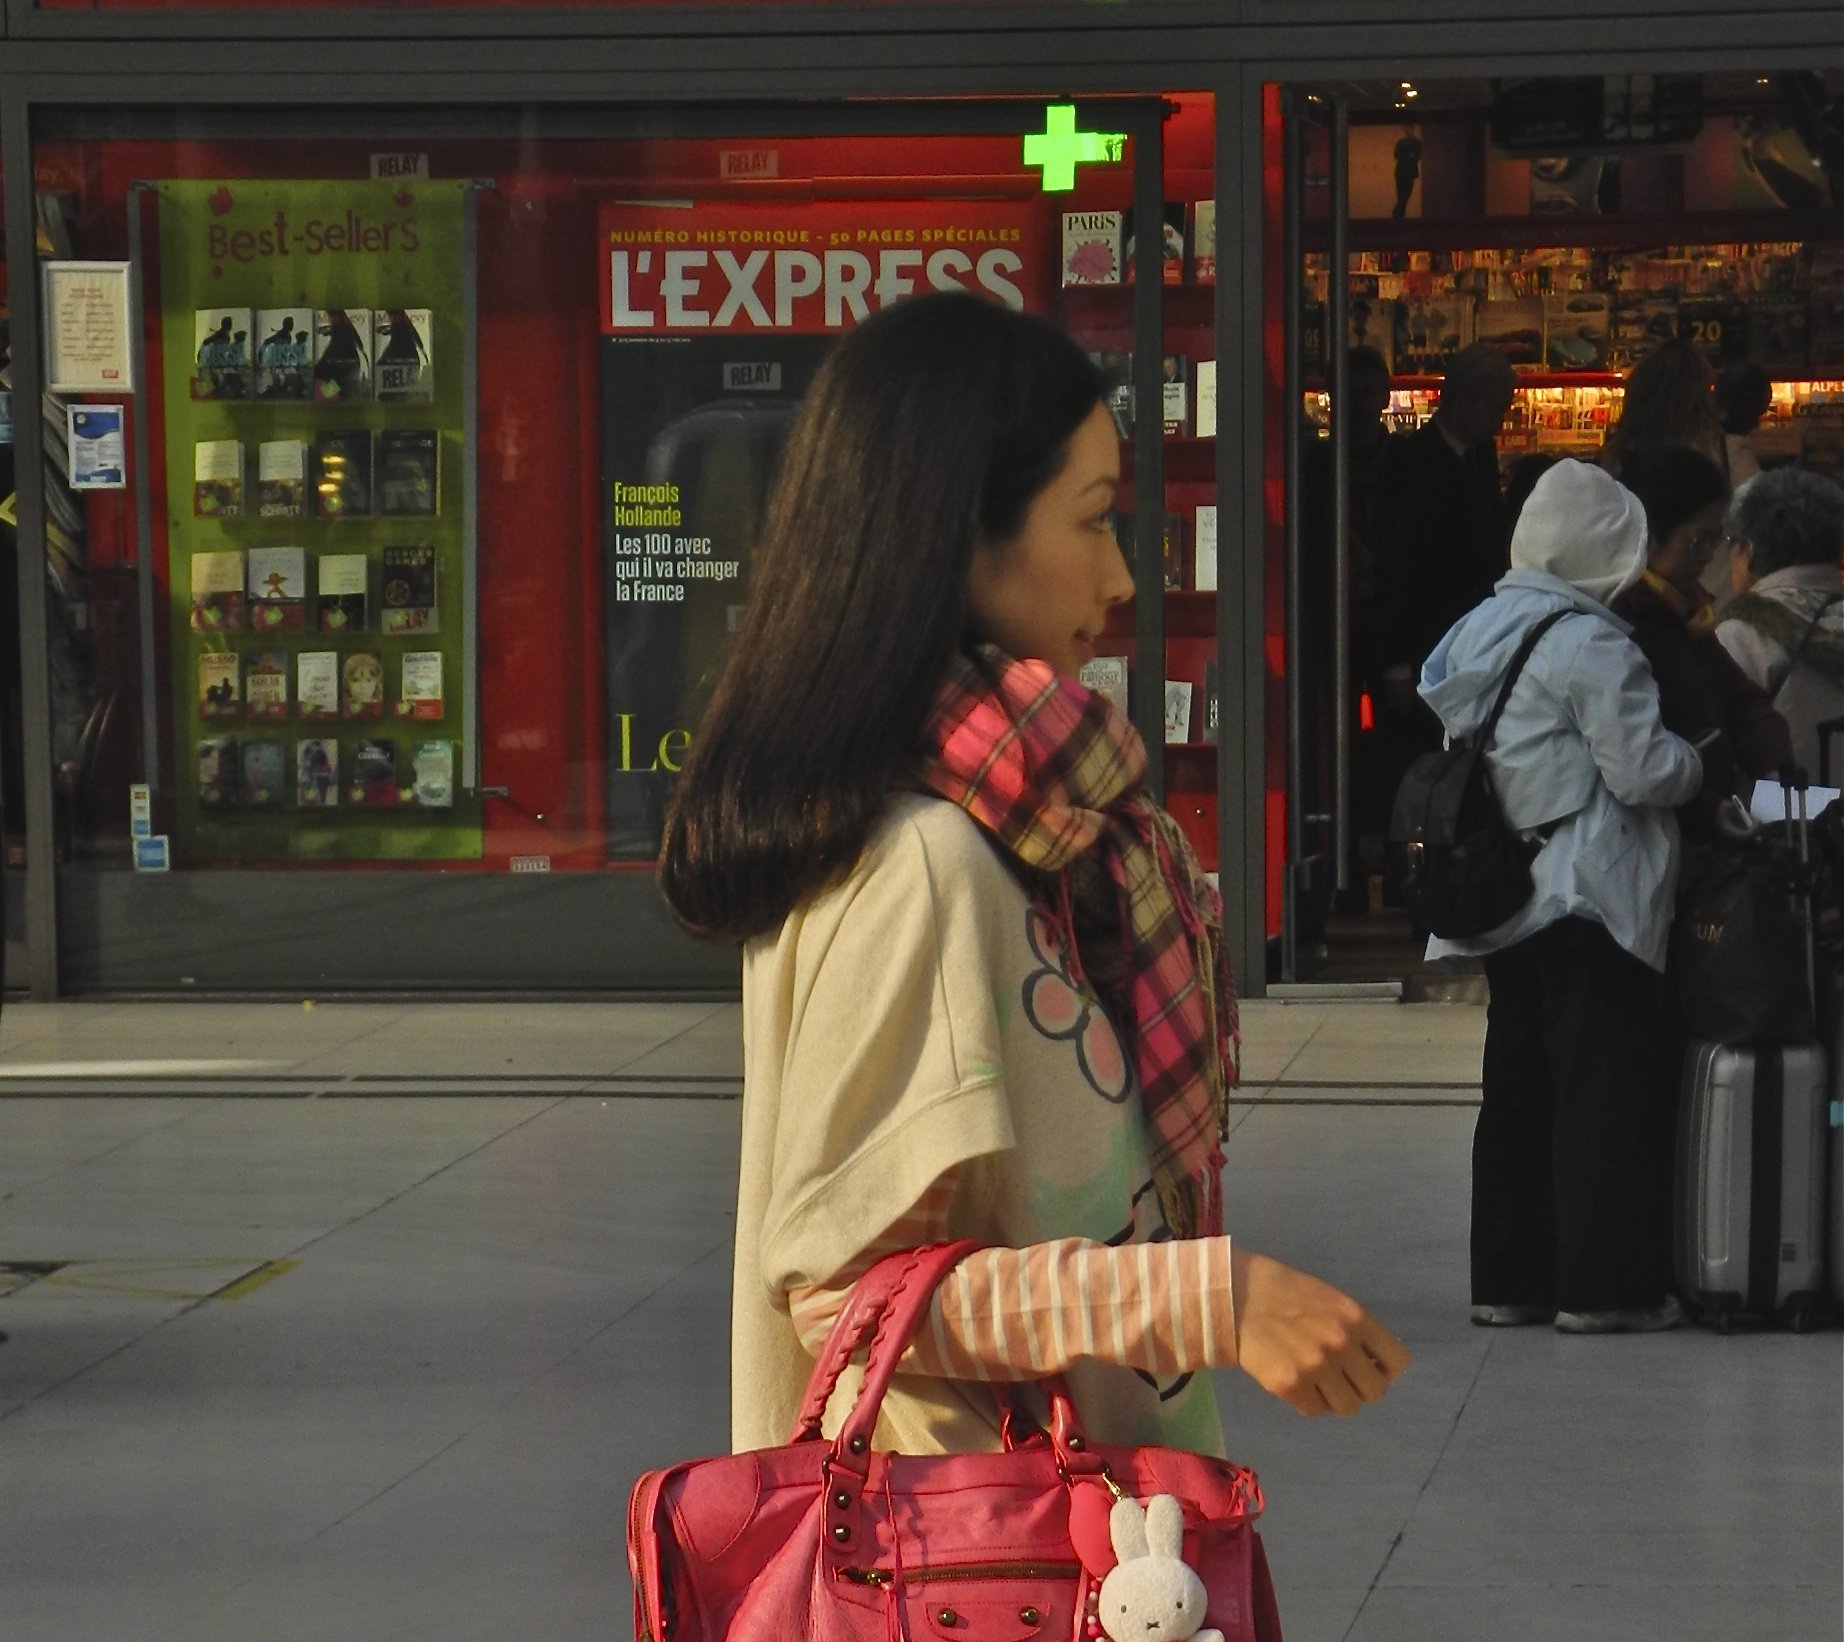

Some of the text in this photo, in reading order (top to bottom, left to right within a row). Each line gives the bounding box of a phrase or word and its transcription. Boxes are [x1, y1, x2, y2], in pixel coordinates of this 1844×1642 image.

[378, 154, 419, 176] RELAY
[729, 151, 768, 174] RELAY
[610, 227, 690, 244] NUMÉRO
[696, 228, 810, 246] HISTORIQUE
[829, 231, 851, 247] 50
[856, 228, 916, 244] PAGES
[921, 224, 1021, 243] SPÉCIALES
[1690, 321, 1721, 343] 20
[731, 365, 771, 386] RELAY
[614, 481, 680, 506] François
[614, 504, 682, 527] Hollande
[615, 533, 712, 555] Les 100 avec
[615, 557, 740, 582] qui il va changer
[616, 580, 685, 602] la France
[615, 712, 695, 774] Le
